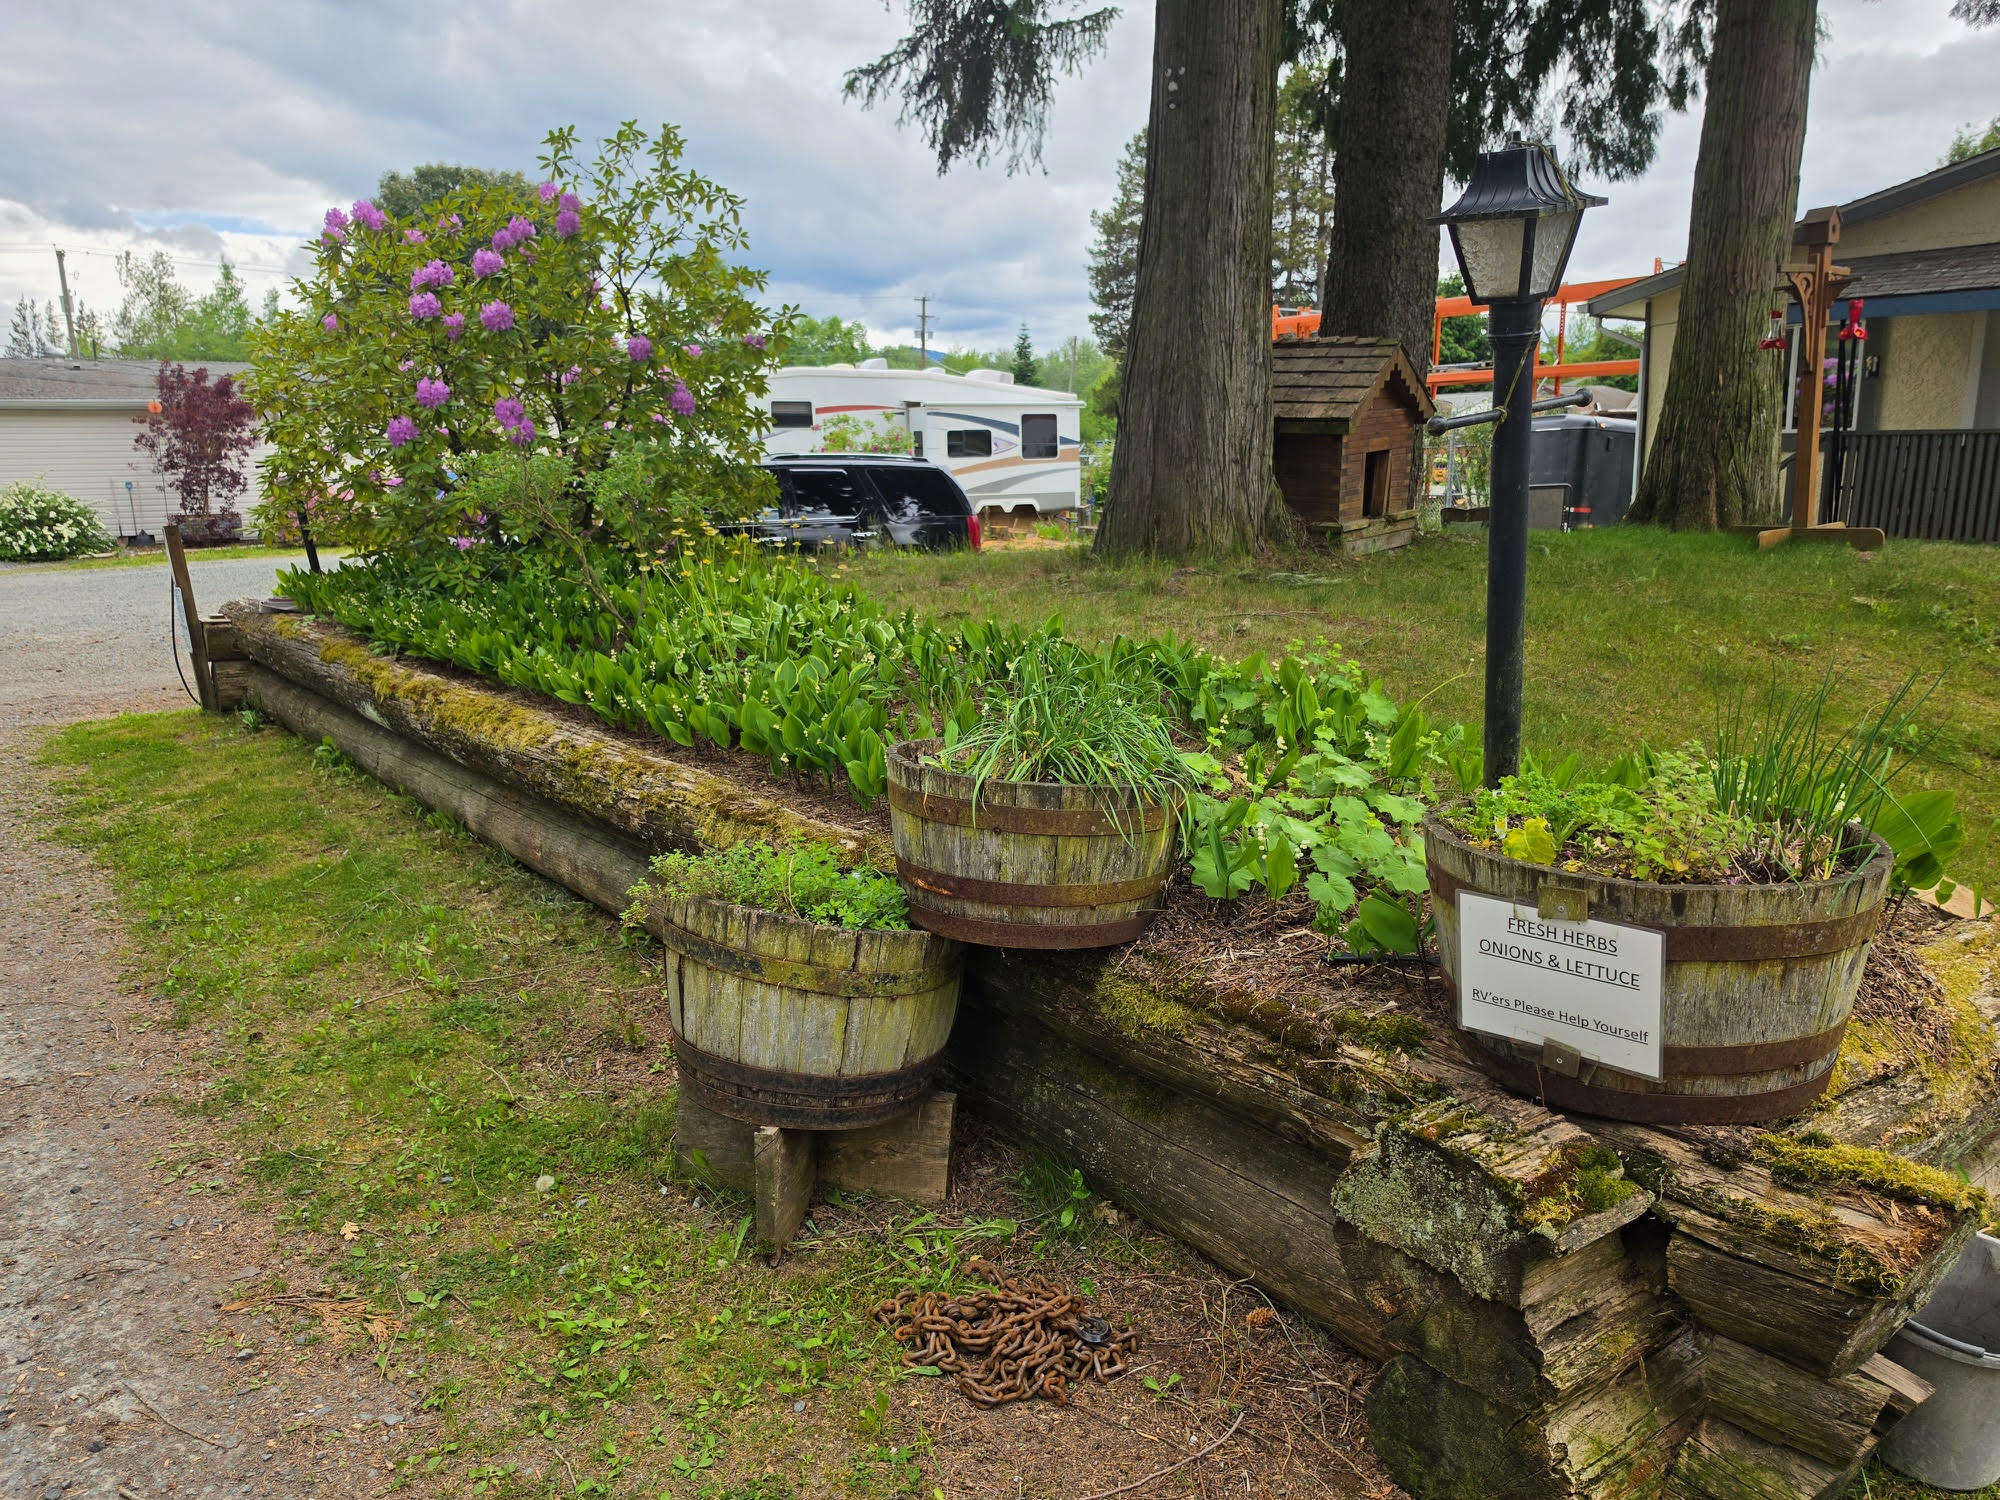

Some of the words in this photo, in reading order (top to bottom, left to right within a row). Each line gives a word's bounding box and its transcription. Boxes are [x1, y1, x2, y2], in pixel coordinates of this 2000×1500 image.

[1507, 917, 1557, 940] FRESH
[1563, 929, 1618, 954] HERBS
[1479, 939, 1543, 965] ONIONS
[1547, 954, 1560, 969] &
[1566, 959, 1640, 988] LETTUCE
[1514, 999, 1555, 1018] Please
[1559, 1011, 1589, 1028] Help
[1593, 1019, 1649, 1043] Yourself
